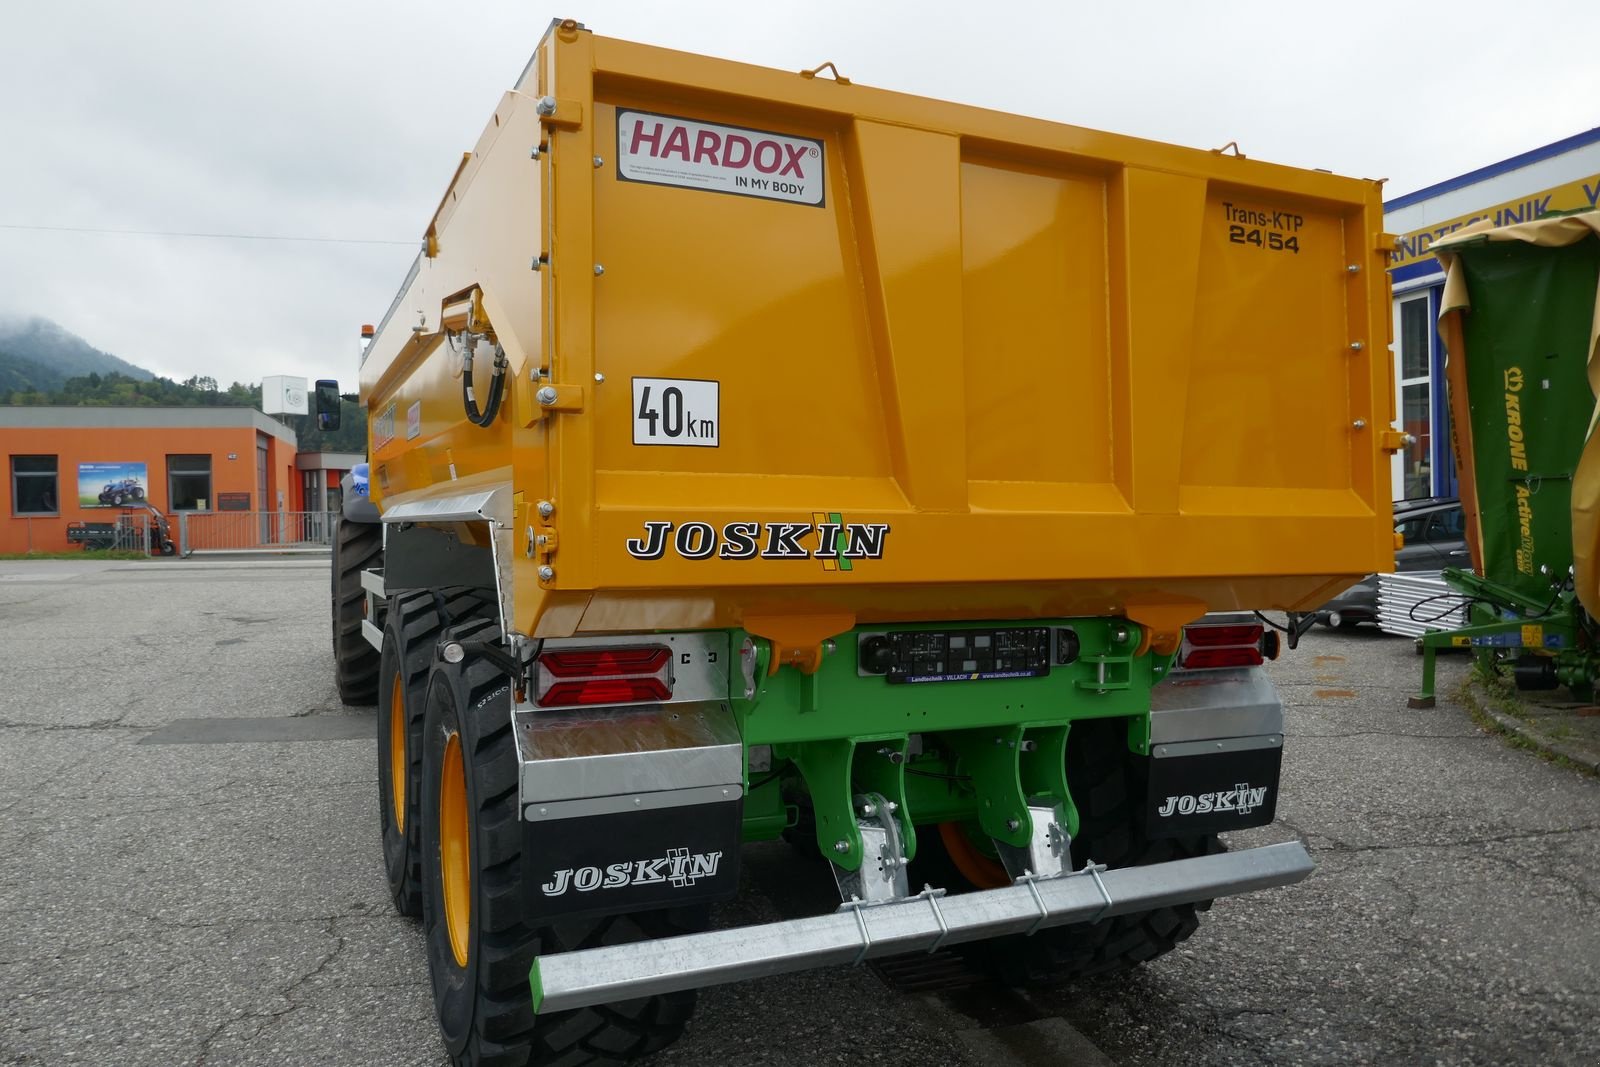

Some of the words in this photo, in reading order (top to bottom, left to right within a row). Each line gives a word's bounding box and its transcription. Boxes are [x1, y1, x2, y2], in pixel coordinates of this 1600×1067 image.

[735, 175, 748, 187] IN
[751, 178, 770, 191] MY
[772, 181, 805, 196] BODY
[1222, 201, 1304, 233] Trans-KTP
[1504, 393, 1528, 472] KRONE
[625, 519, 892, 561] JOSKIN
[911, 675, 943, 683] Landtechnik
[946, 674, 968, 682] VILLACH
[1158, 785, 1268, 817] JOSKIN
[541, 849, 723, 897] JOSKIN
